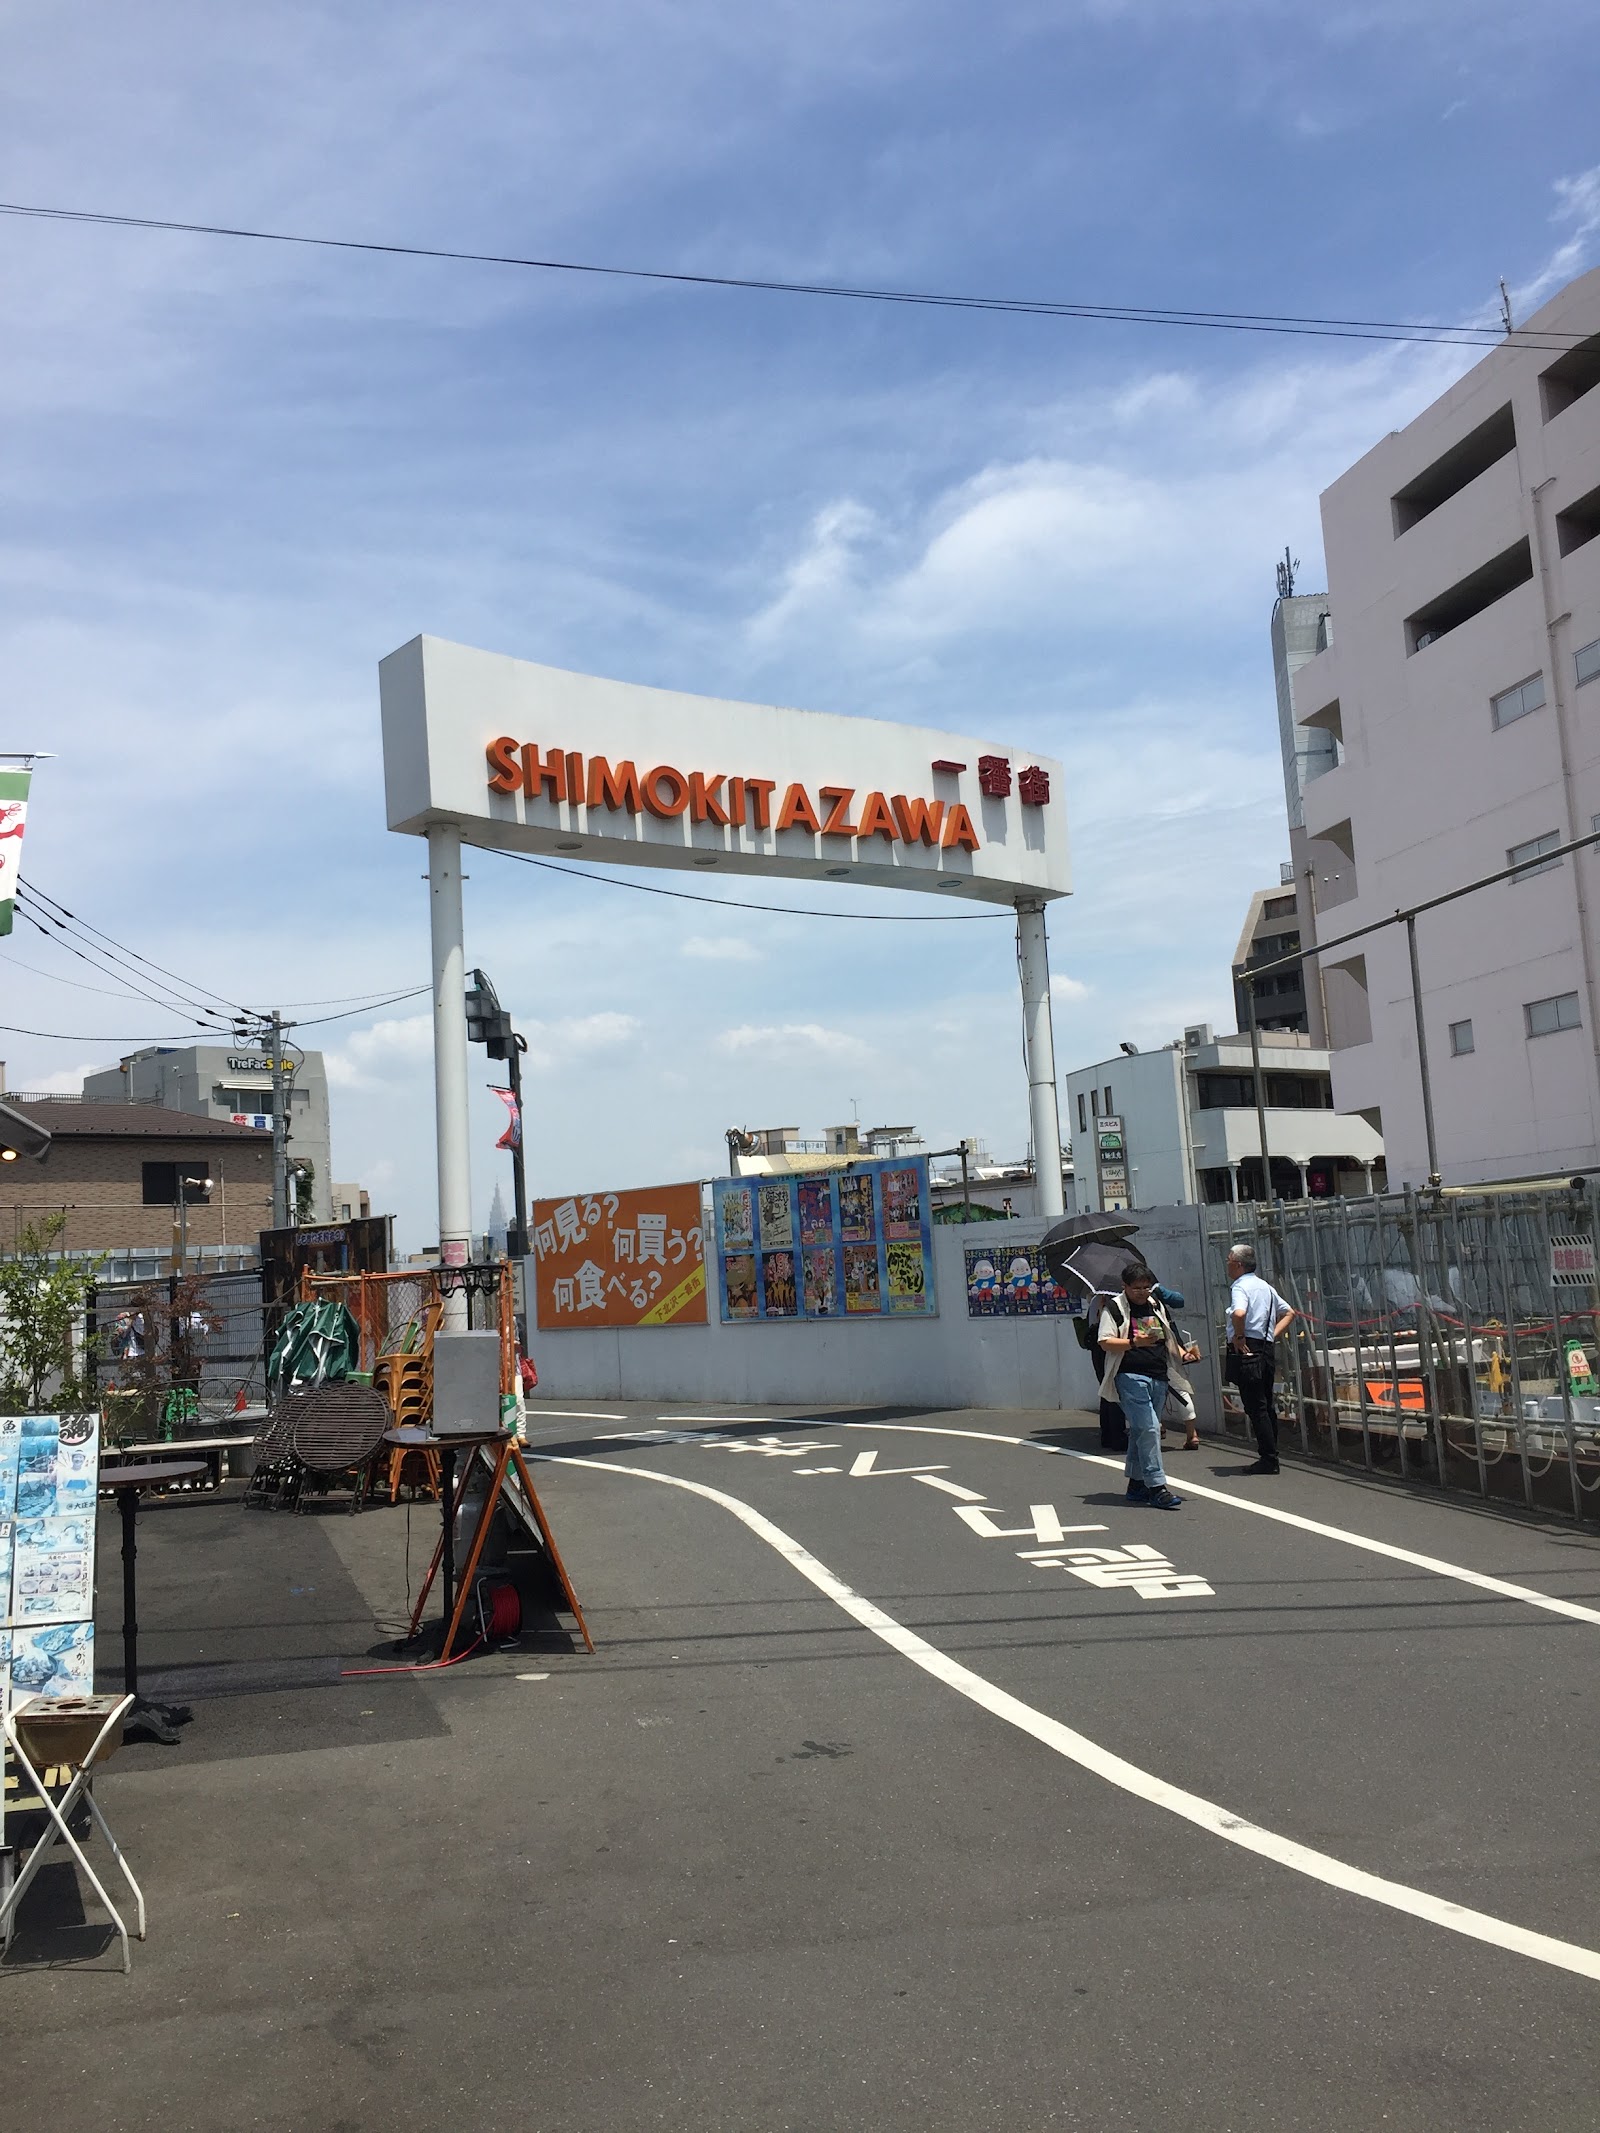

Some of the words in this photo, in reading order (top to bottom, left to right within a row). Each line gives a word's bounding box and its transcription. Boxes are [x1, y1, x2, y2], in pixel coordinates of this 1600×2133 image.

[486, 736, 980, 853] SHIMOKITAZAWA
[931, 754, 1051, 807] 一番街
[228, 1057, 294, 1072] TreFacSle
[535, 1194, 620, 1262] 何見る?
[613, 1213, 704, 1267] 何買う?
[552, 1259, 662, 1313] 何食べる?
[655, 1275, 701, 1321] 下北沢一番街
